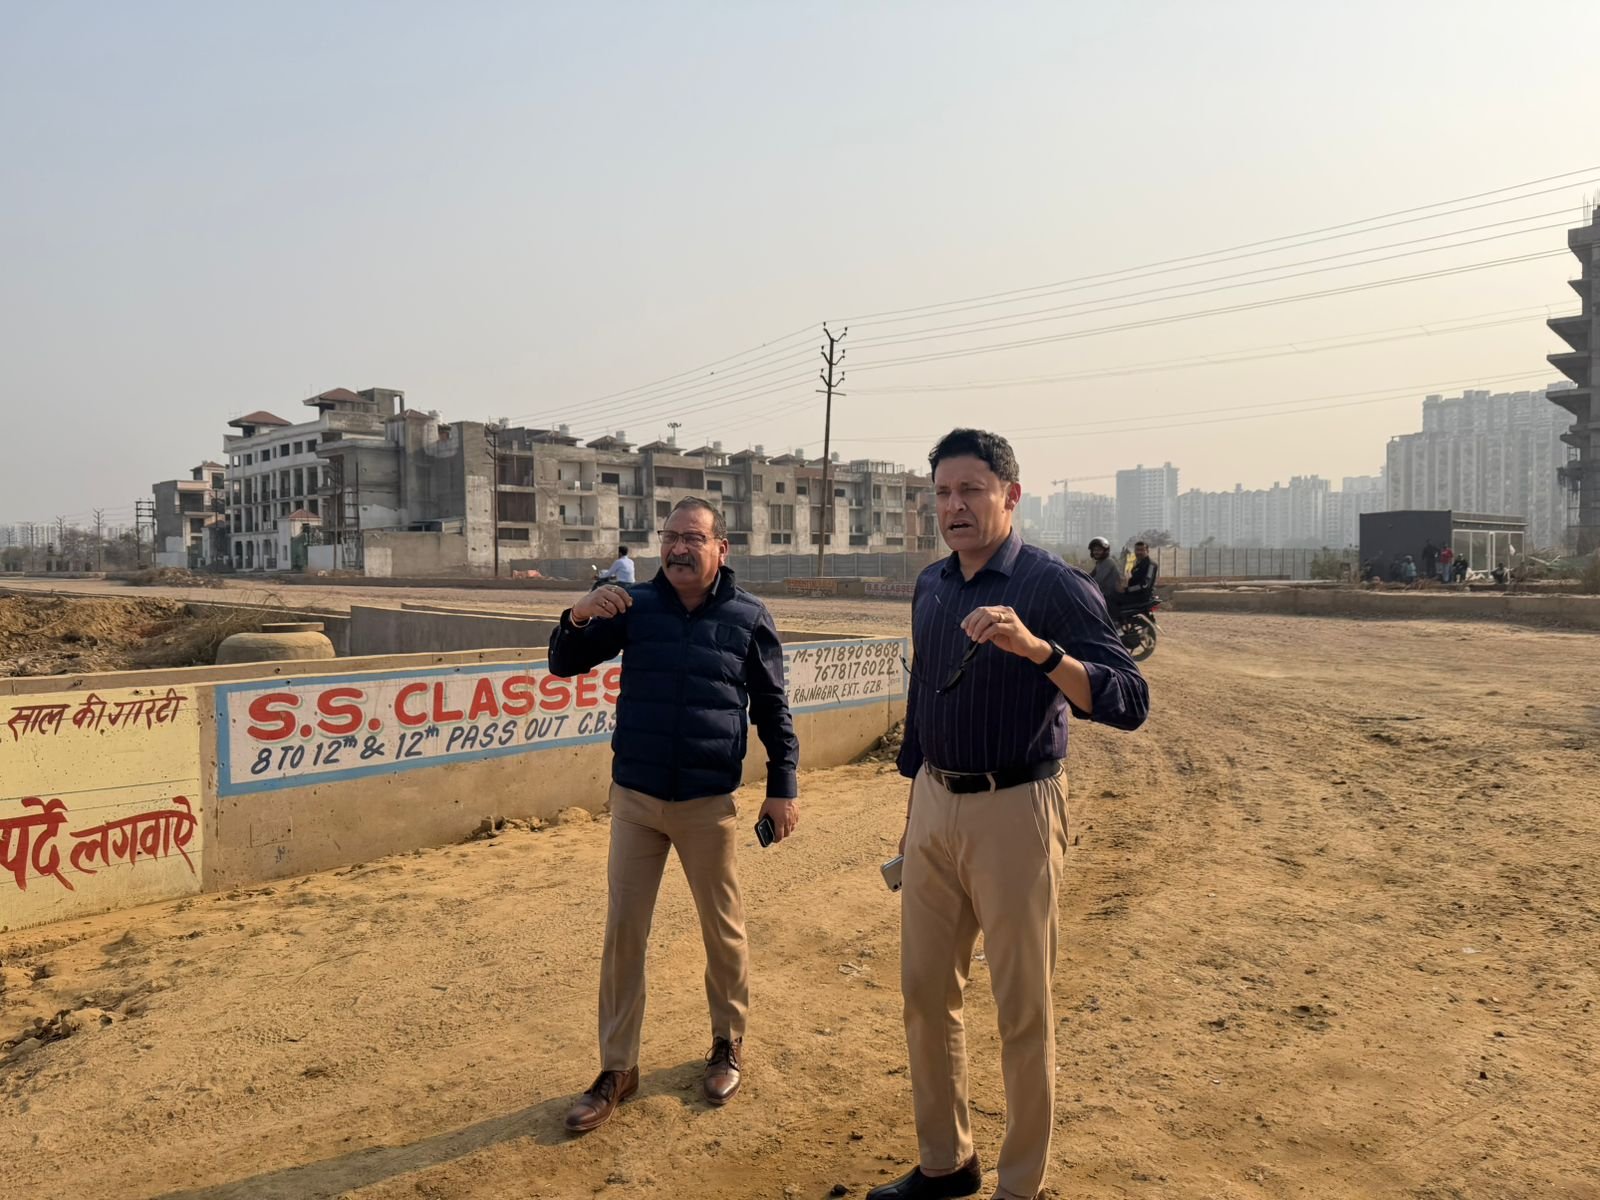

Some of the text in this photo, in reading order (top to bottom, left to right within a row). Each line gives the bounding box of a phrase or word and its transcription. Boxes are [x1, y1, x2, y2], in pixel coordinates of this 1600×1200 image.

[7, 703, 72, 742] साल
[72, 692, 107, 731] की
[247, 667, 621, 742] S.S. CLASSES
[792, 683, 841, 704] RAJNAGAR
[251, 747, 272, 776] 8
[278, 743, 305, 771] TO
[360, 735, 386, 761] &
[446, 718, 516, 753] PASS
[525, 714, 570, 739] OUT
